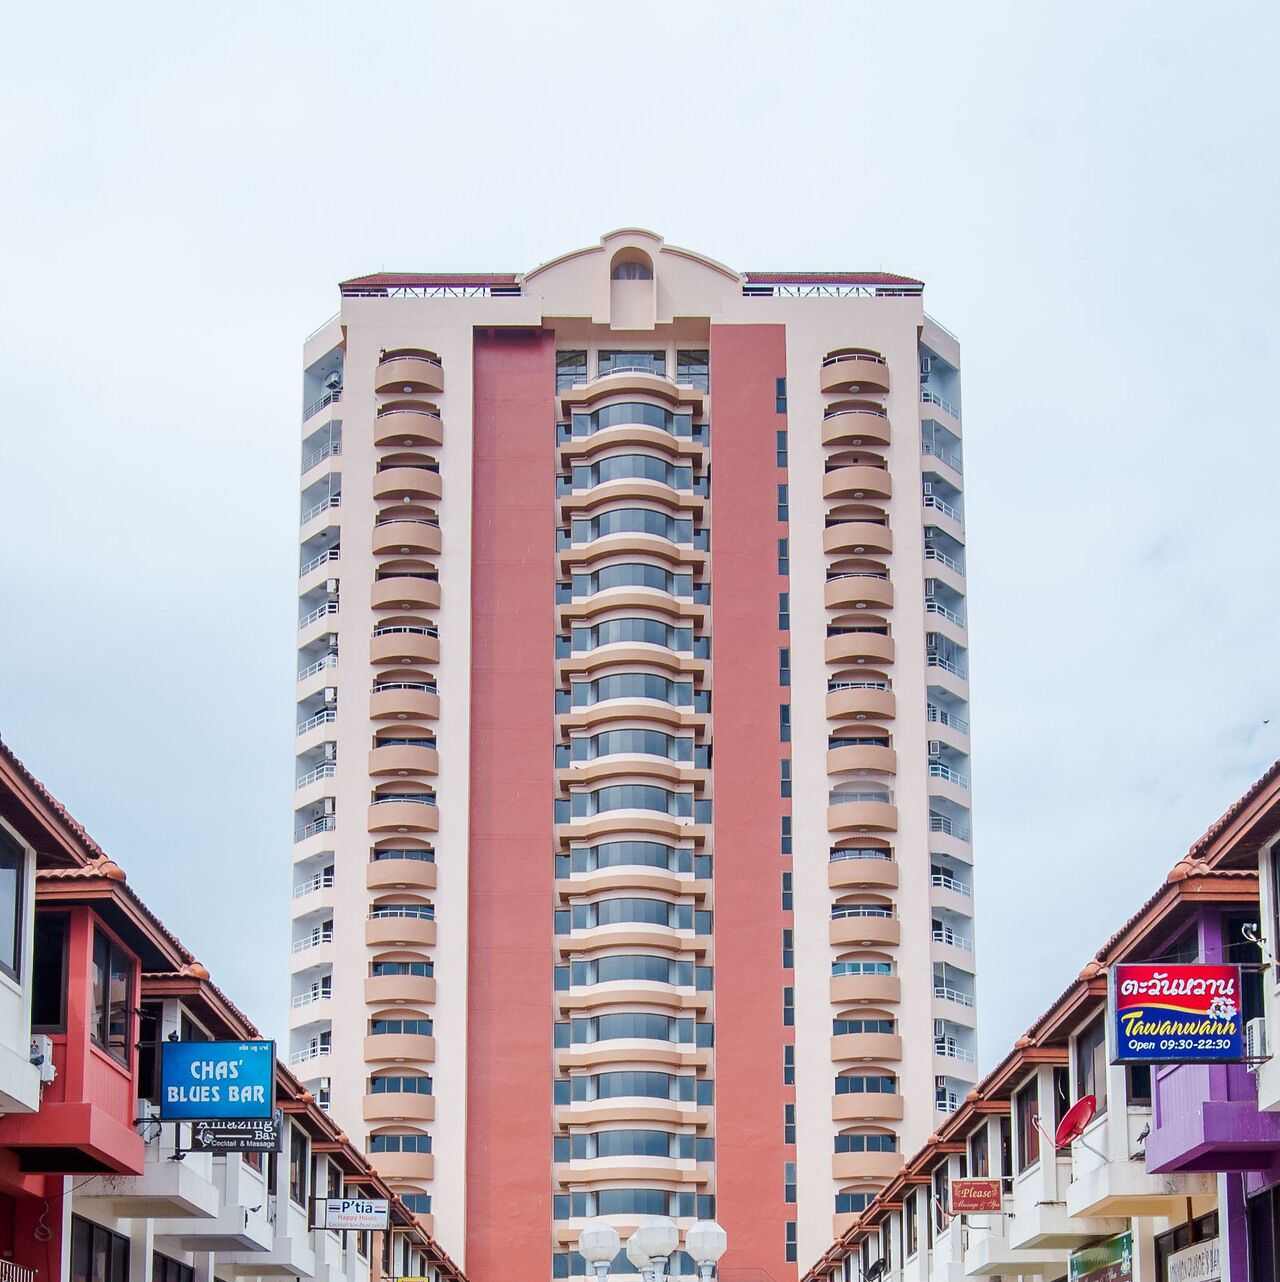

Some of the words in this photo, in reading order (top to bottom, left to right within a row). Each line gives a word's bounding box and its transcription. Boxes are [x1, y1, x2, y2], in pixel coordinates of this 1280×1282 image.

[1120, 971, 1235, 996] ตะวันหวาน
[1121, 1010, 1238, 1037] Tawanwann
[1128, 1039, 1156, 1052] Open
[1159, 1039, 1232, 1050] 09:30-22:30
[190, 1060, 244, 1081] CHAS'
[167, 1085, 221, 1103] BLUES
[228, 1085, 266, 1104] BAR
[254, 1130, 278, 1141] Bar
[211, 1140, 238, 1148] Cocktail
[246, 1140, 276, 1149] Massage
[961, 1187, 992, 1198] Please
